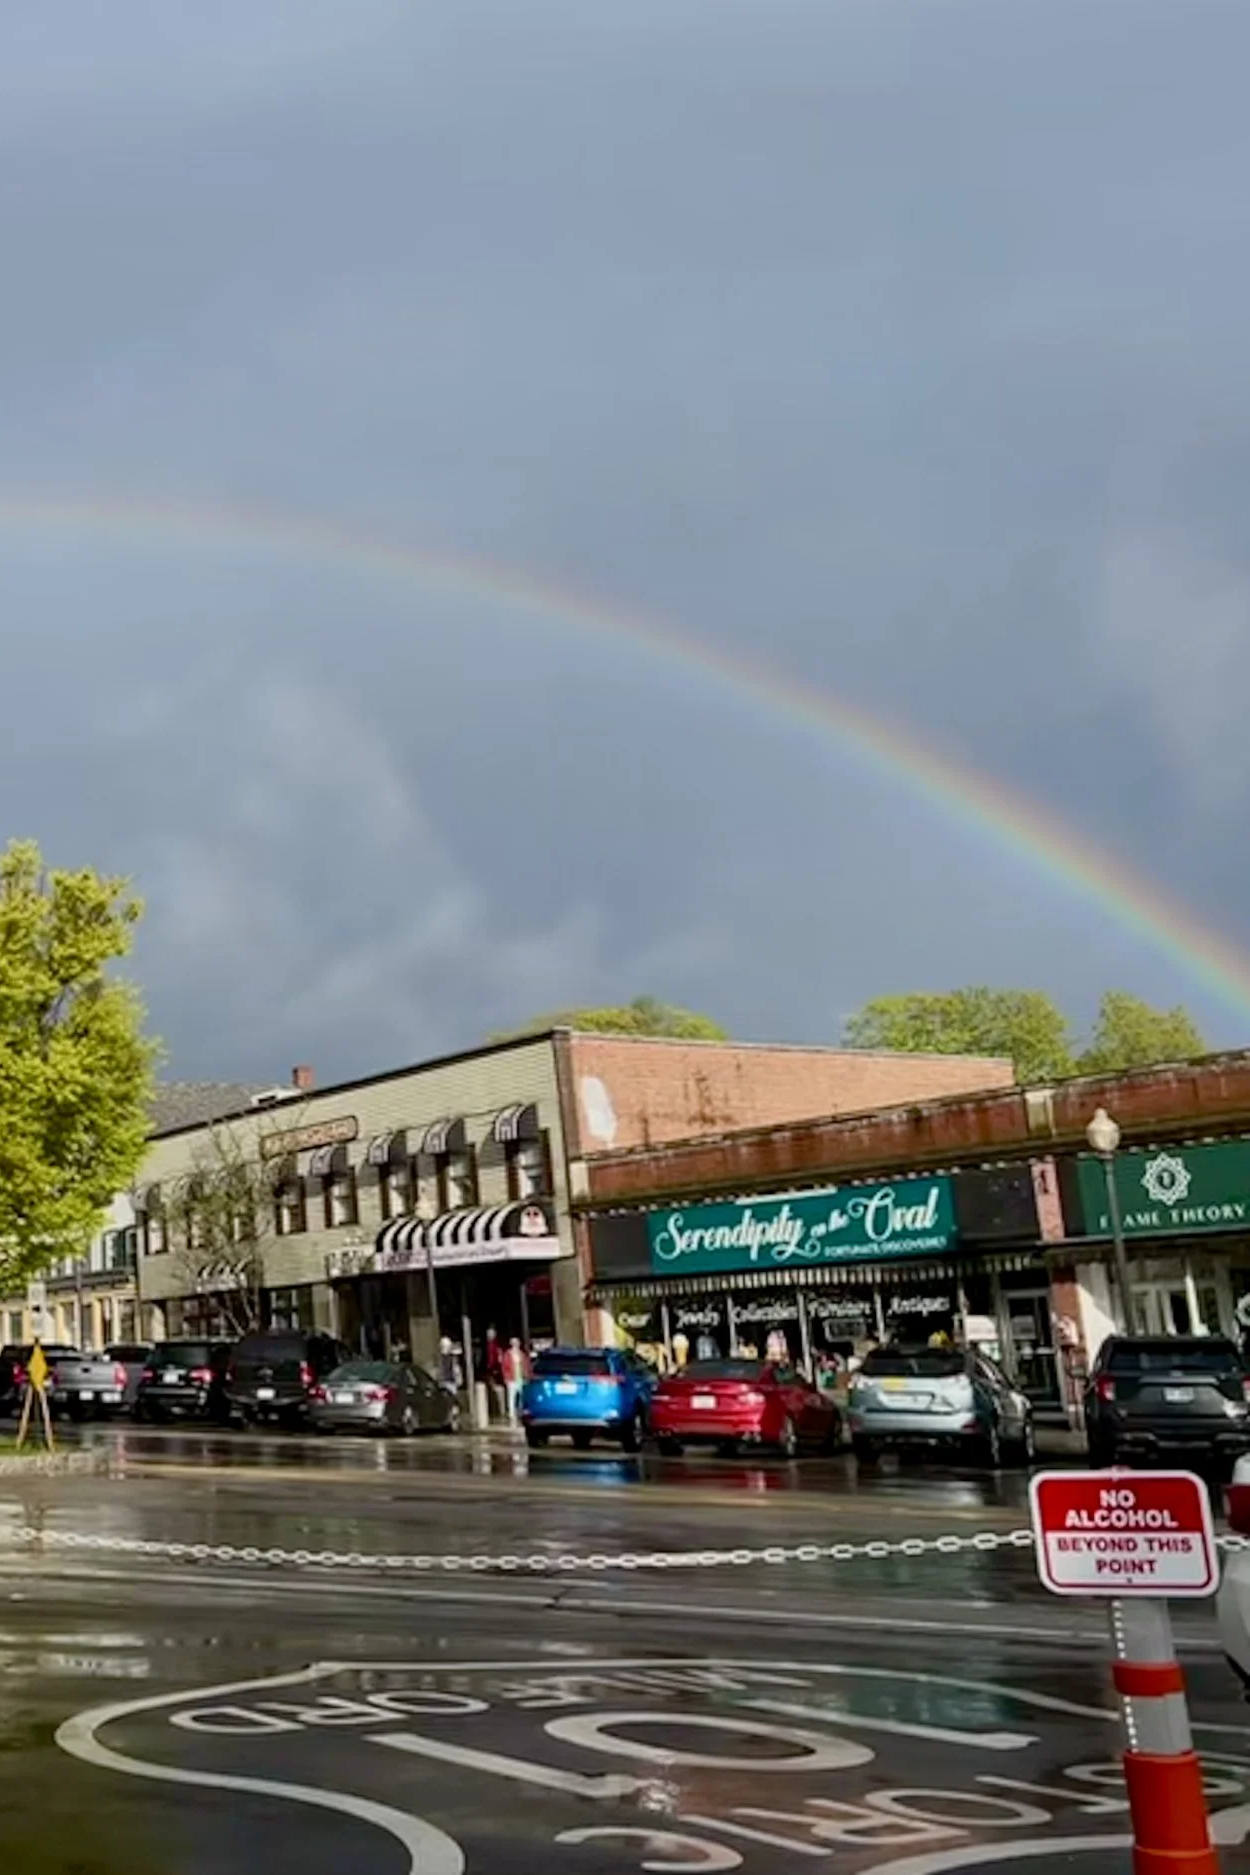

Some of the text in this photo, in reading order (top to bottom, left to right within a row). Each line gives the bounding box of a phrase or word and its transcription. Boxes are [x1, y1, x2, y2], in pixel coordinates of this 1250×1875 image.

[654, 1203, 821, 1262] Serendipity
[847, 1187, 940, 1242] Oval
[1100, 1203, 1247, 1230] FAME THEORY
[1099, 1489, 1136, 1508] NO
[1064, 1509, 1179, 1528] ALCOHOL
[1056, 1536, 1194, 1553] BEYOND THIS
[1095, 1559, 1158, 1575] POINT
[362, 1697, 1042, 1797] 101
